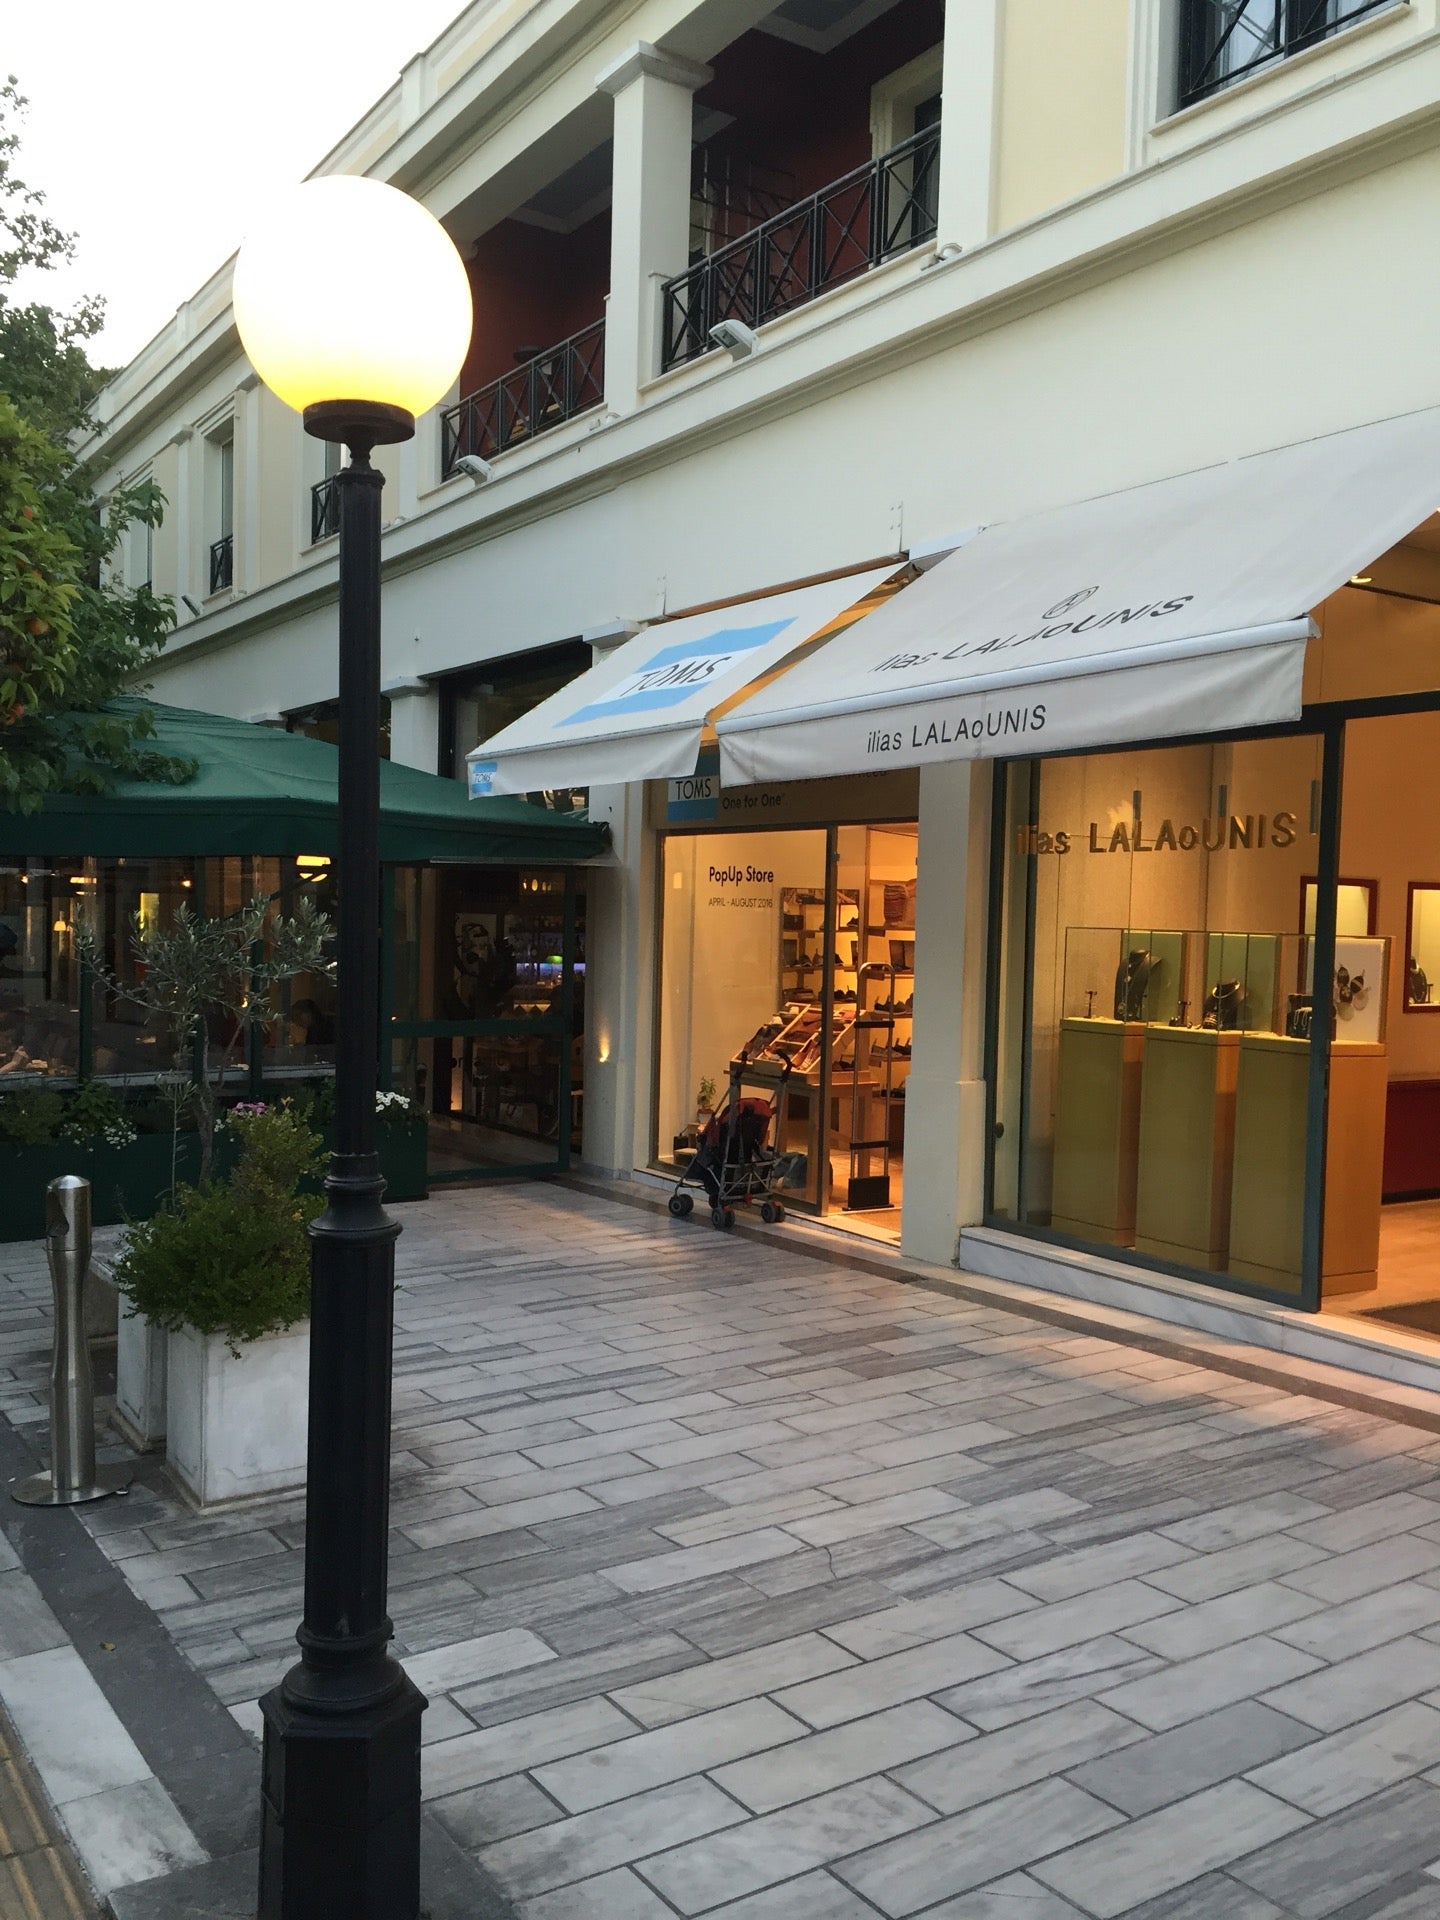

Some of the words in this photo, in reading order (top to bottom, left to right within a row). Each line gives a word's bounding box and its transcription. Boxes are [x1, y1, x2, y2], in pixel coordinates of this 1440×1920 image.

[620, 656, 732, 697] TOMS
[866, 731, 902, 753] ilias
[911, 704, 1046, 748] LALAoUNIS
[474, 772, 493, 783] TOMS
[675, 778, 711, 800] TOMS
[722, 796, 742, 810] One
[744, 795, 758, 808] for
[1089, 812, 1297, 853] LALAoUNIS
[709, 866, 743, 887] PopUp
[745, 865, 774, 883] Store
[708, 897, 726, 907] APRIL
[730, 898, 757, 908] AUGUST
[757, 898, 774, 908] 2016
